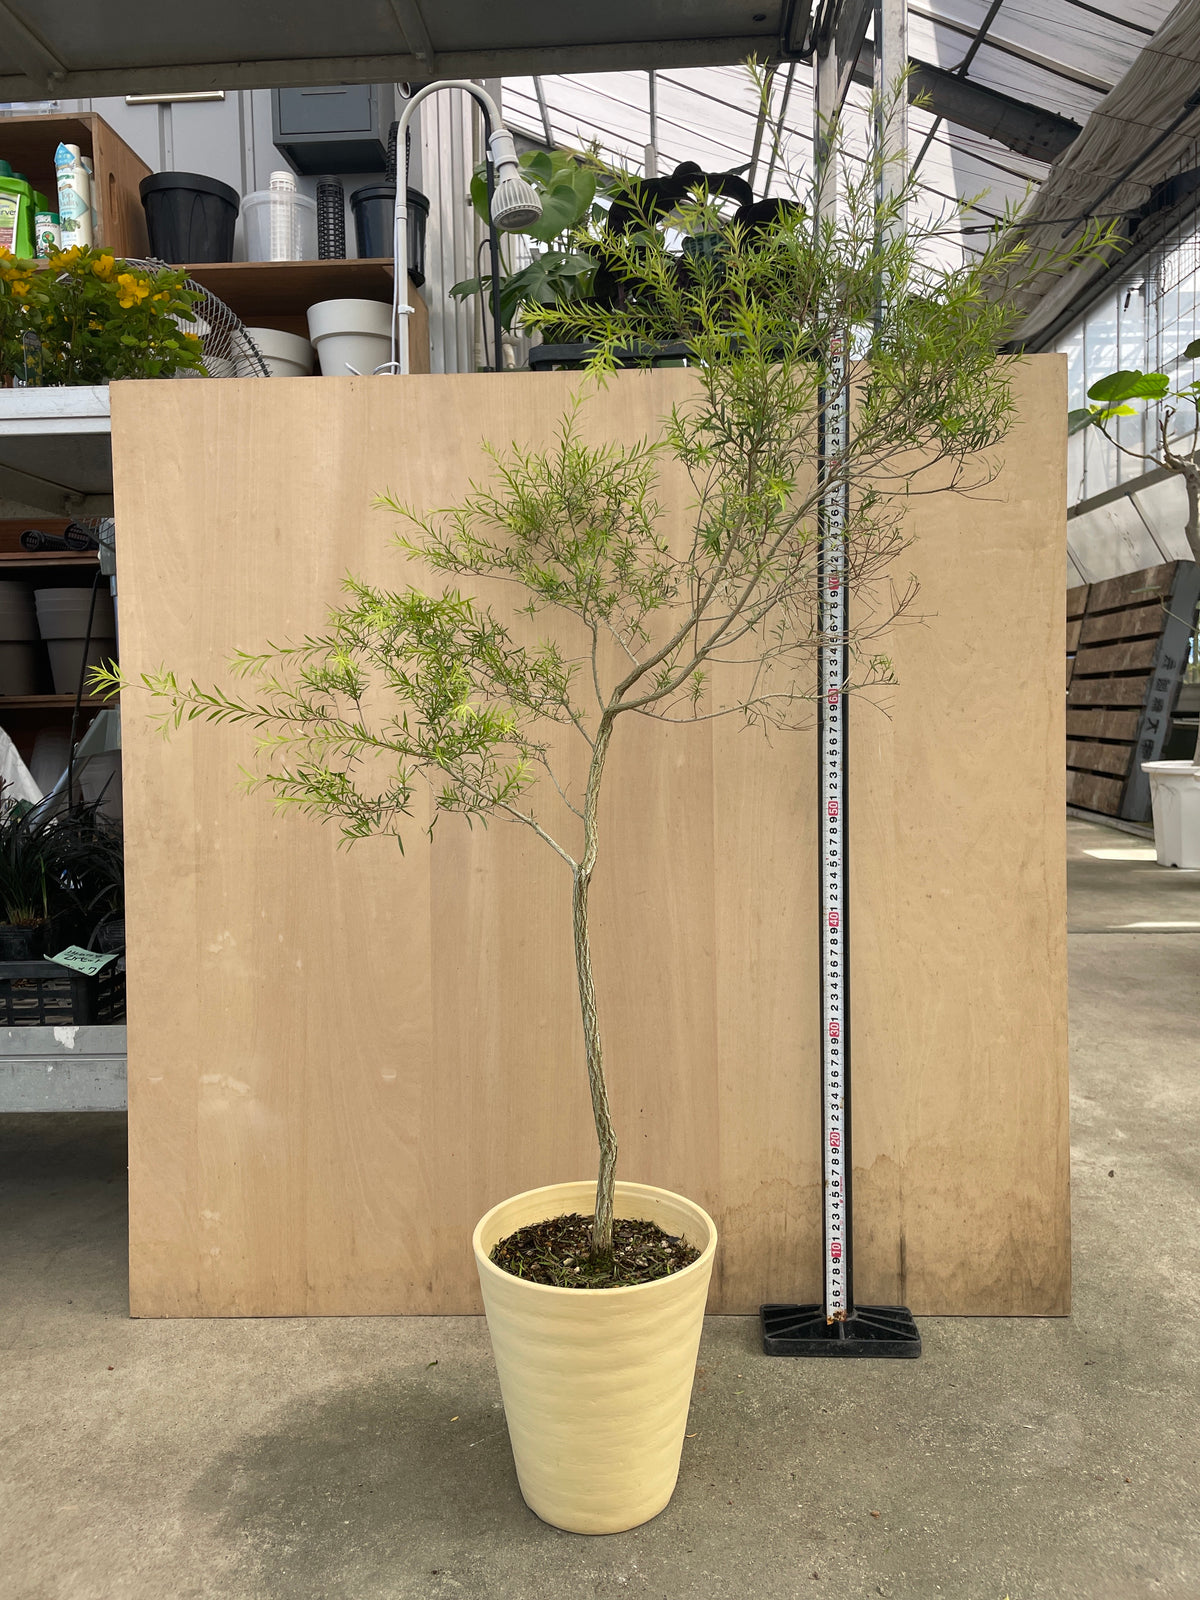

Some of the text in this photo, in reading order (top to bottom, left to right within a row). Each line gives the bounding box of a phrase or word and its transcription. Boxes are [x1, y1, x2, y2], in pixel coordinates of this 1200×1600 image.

[829, 802, 839, 816] 50
[829, 913, 839, 927] 40
[830, 1023, 840, 1037] 30
[831, 1132, 841, 1147] 20
[832, 1243, 842, 1257] 10
